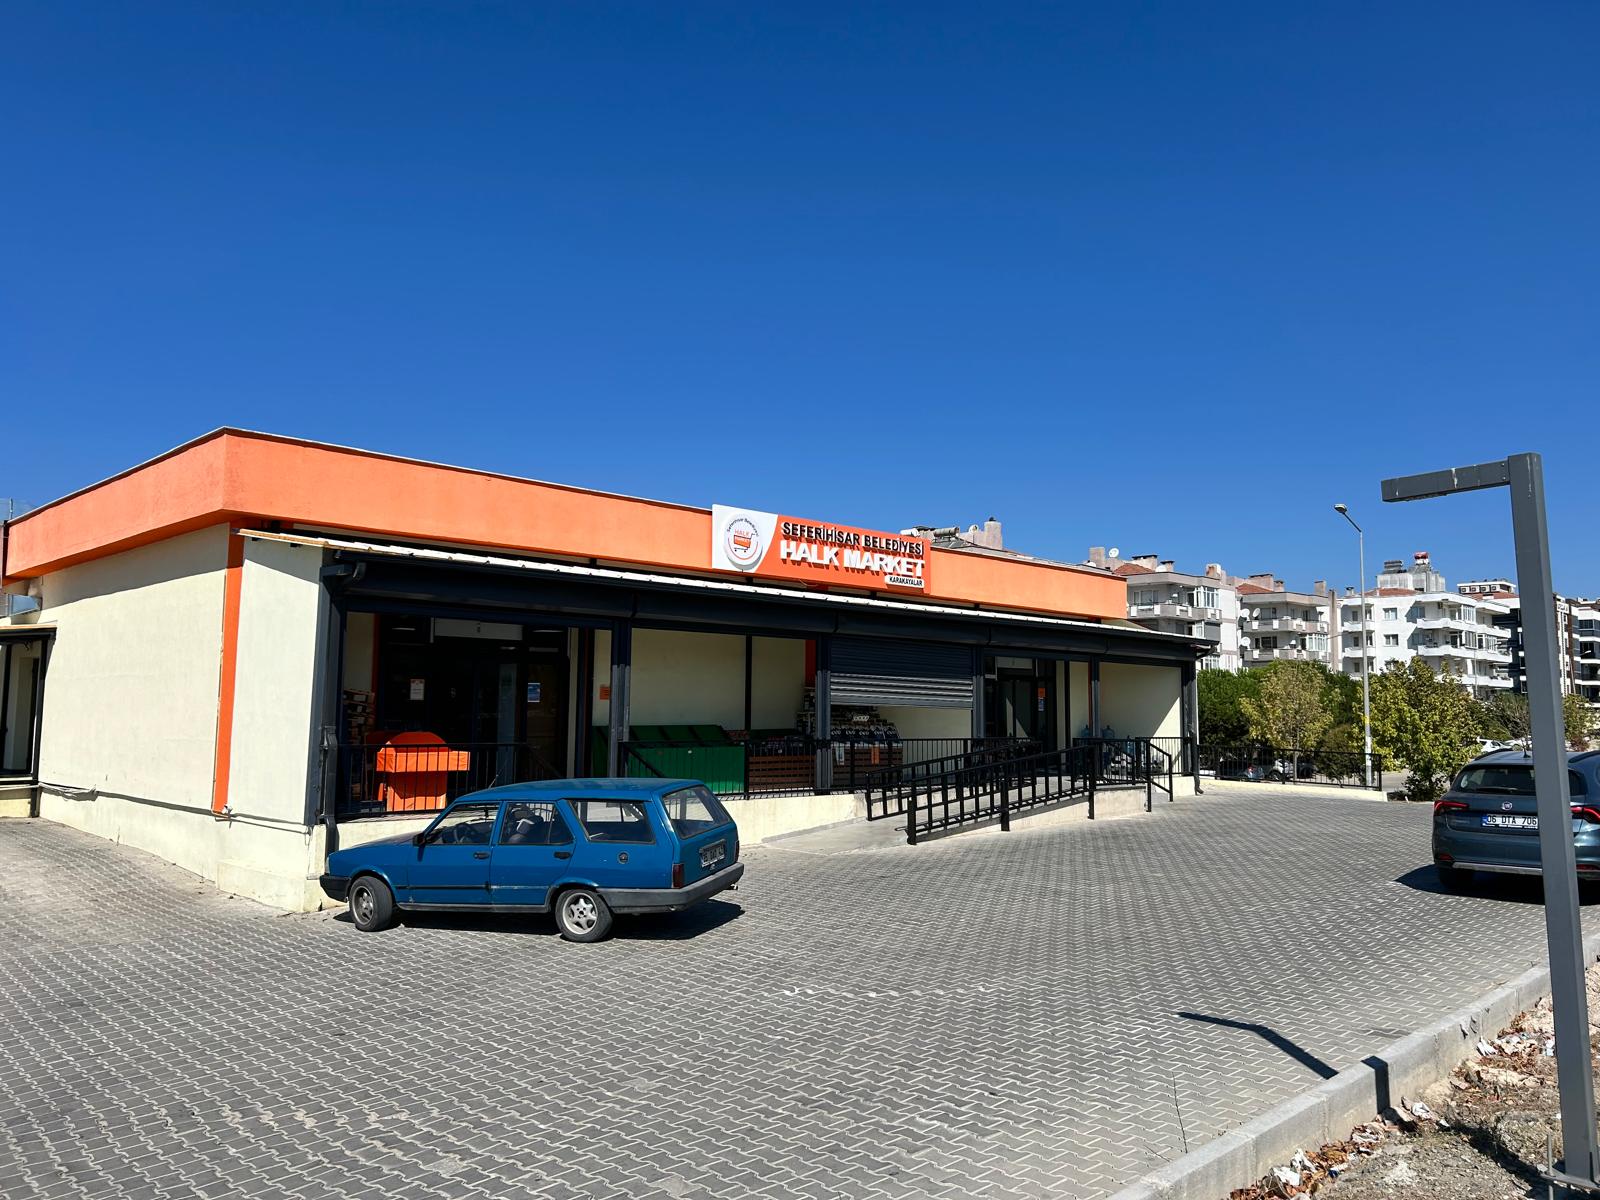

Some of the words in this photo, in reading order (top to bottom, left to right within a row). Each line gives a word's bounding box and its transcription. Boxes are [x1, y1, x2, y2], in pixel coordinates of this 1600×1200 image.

[782, 521, 860, 545] SEFERİHİSAR
[863, 535, 924, 556] BELEDİYESİ
[780, 539, 840, 567] HALK
[843, 549, 925, 577] MARKET
[889, 576, 923, 587] KARAKAYALAR
